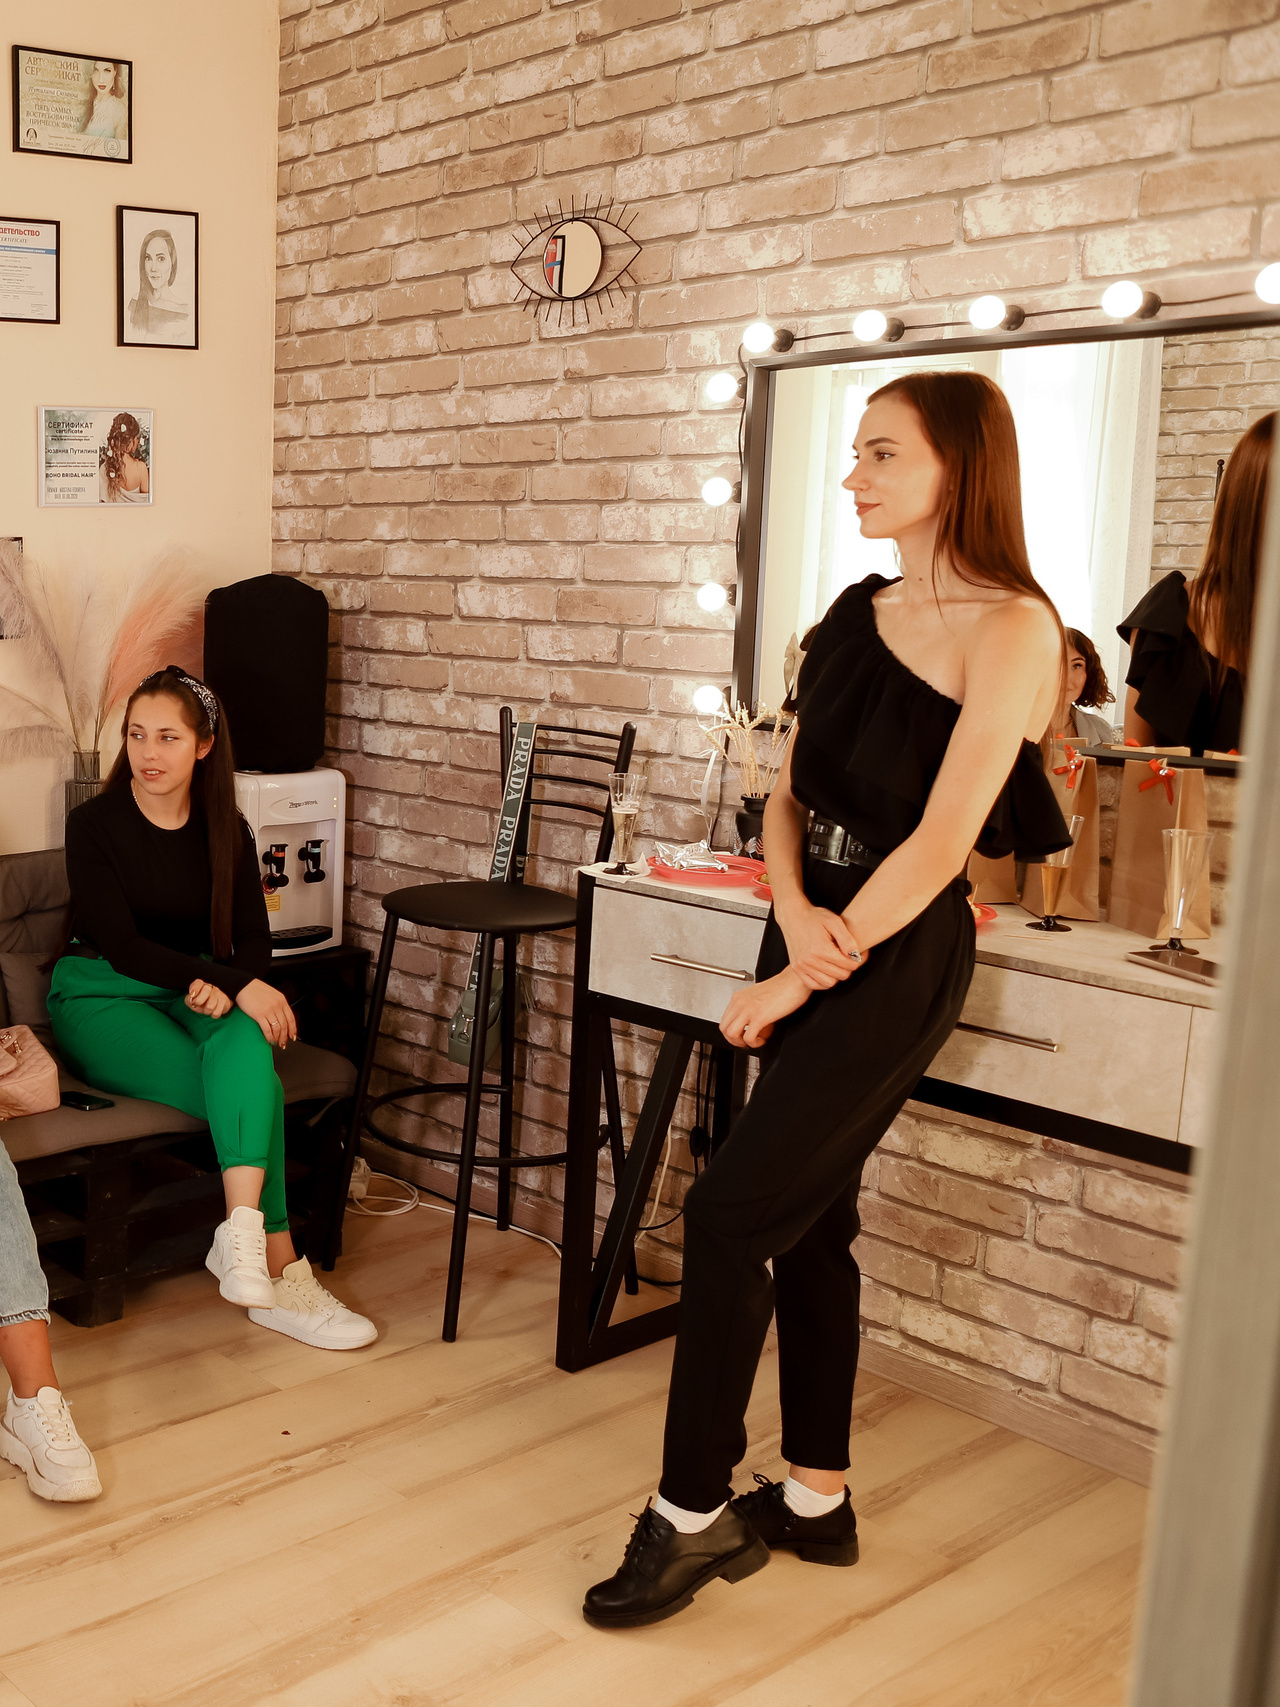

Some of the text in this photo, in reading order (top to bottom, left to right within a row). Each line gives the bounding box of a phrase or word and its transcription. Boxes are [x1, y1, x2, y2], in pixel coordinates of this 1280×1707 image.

[26, 56, 79, 71] АВТОСКИЙ
[24, 66, 81, 81] СЕРТФИКАТ
[47, 421, 94, 429] СЕРТИФИКАТ
[69, 447, 98, 455] Путилина
[505, 736, 531, 802] PRADA
[490, 815, 516, 880] PRADA
